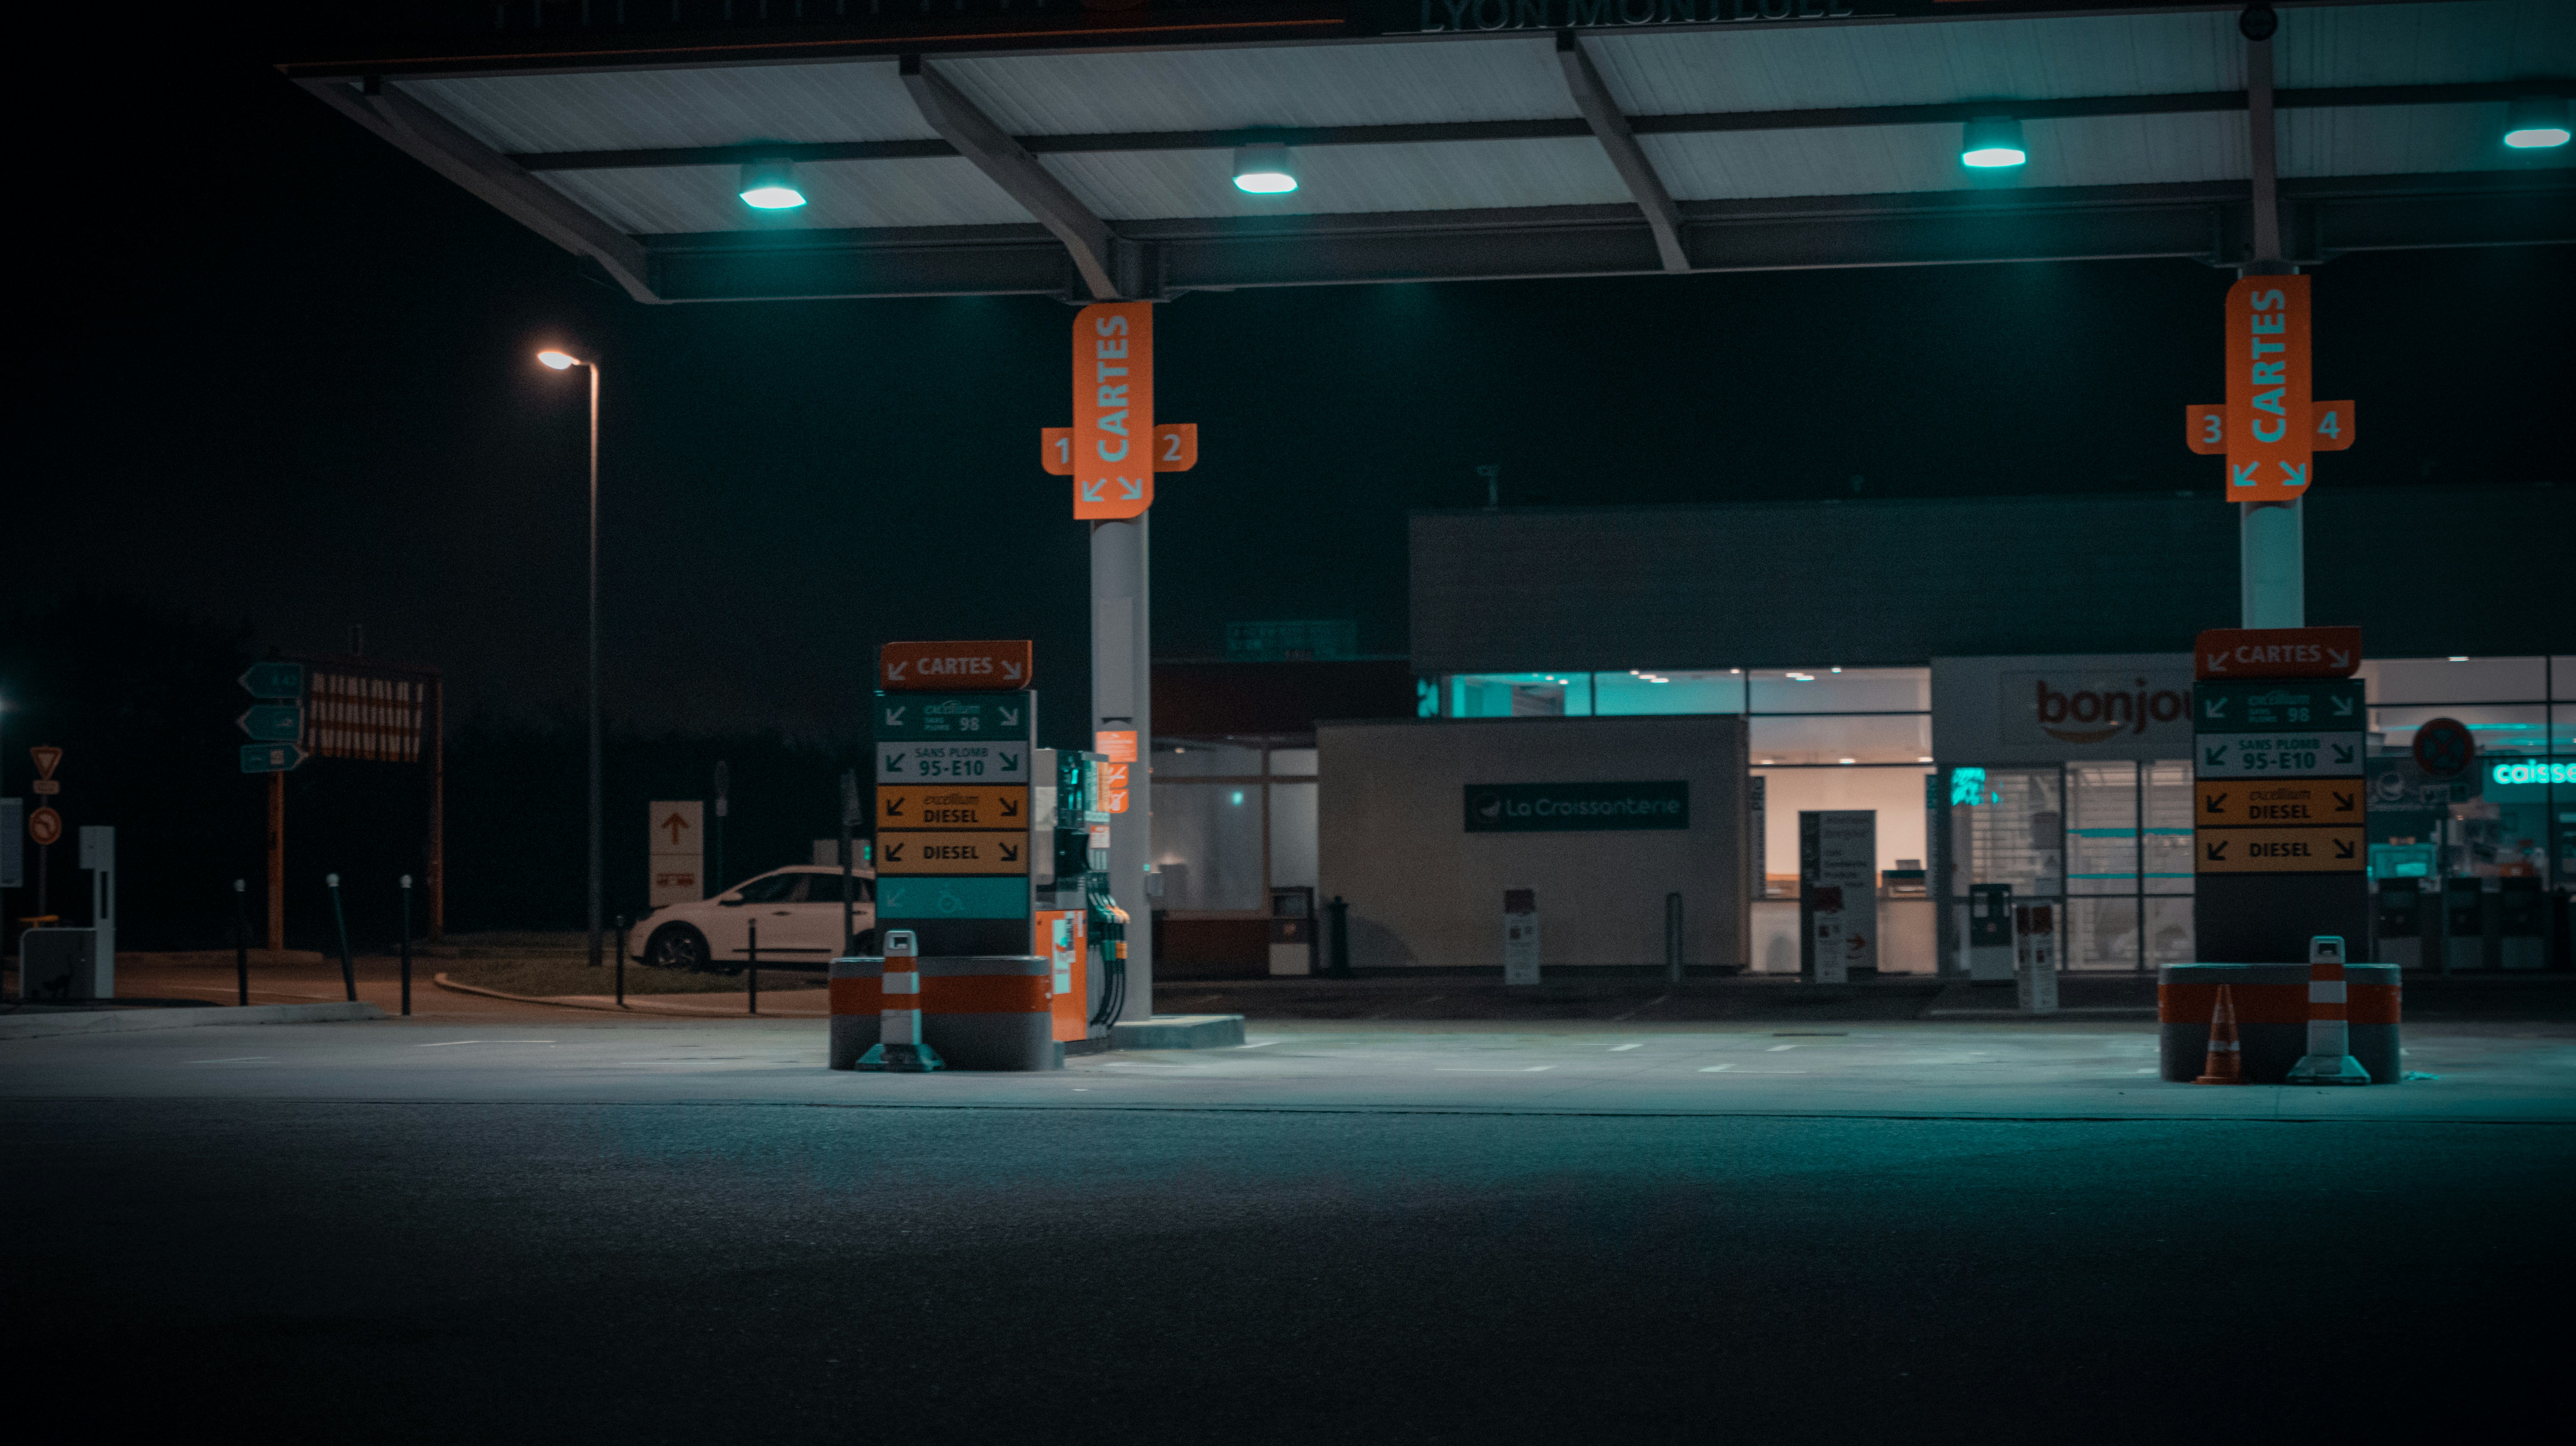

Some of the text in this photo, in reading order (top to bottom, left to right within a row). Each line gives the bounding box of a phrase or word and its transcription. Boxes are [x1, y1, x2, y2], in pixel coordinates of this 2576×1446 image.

[1421, 0, 1549, 32] LYON
[2252, 289, 2286, 442] CARTES
[1096, 315, 1128, 462] CARTES
[2203, 415, 2222, 443] 3
[2318, 411, 2340, 439] 4
[1055, 437, 1069, 464] 1
[1163, 434, 1182, 461] 2
[2236, 645, 2321, 664] CARTES
[917, 657, 993, 675] CARTES
[2287, 707, 2311, 723] 98
[960, 717, 980, 731] 98
[915, 747, 988, 758] SANS PLOMB
[2239, 739, 2320, 750] SANS PLOMB
[920, 760, 984, 776] 95-E10
[2243, 752, 2316, 769] 95-E10
[1507, 798, 1680, 817] La Croissanterie
[2249, 805, 2311, 819] DIESEL
[924, 810, 978, 823] DIESEL
[924, 846, 978, 860] DIESEL
[2250, 843, 2311, 857] DIESEL
